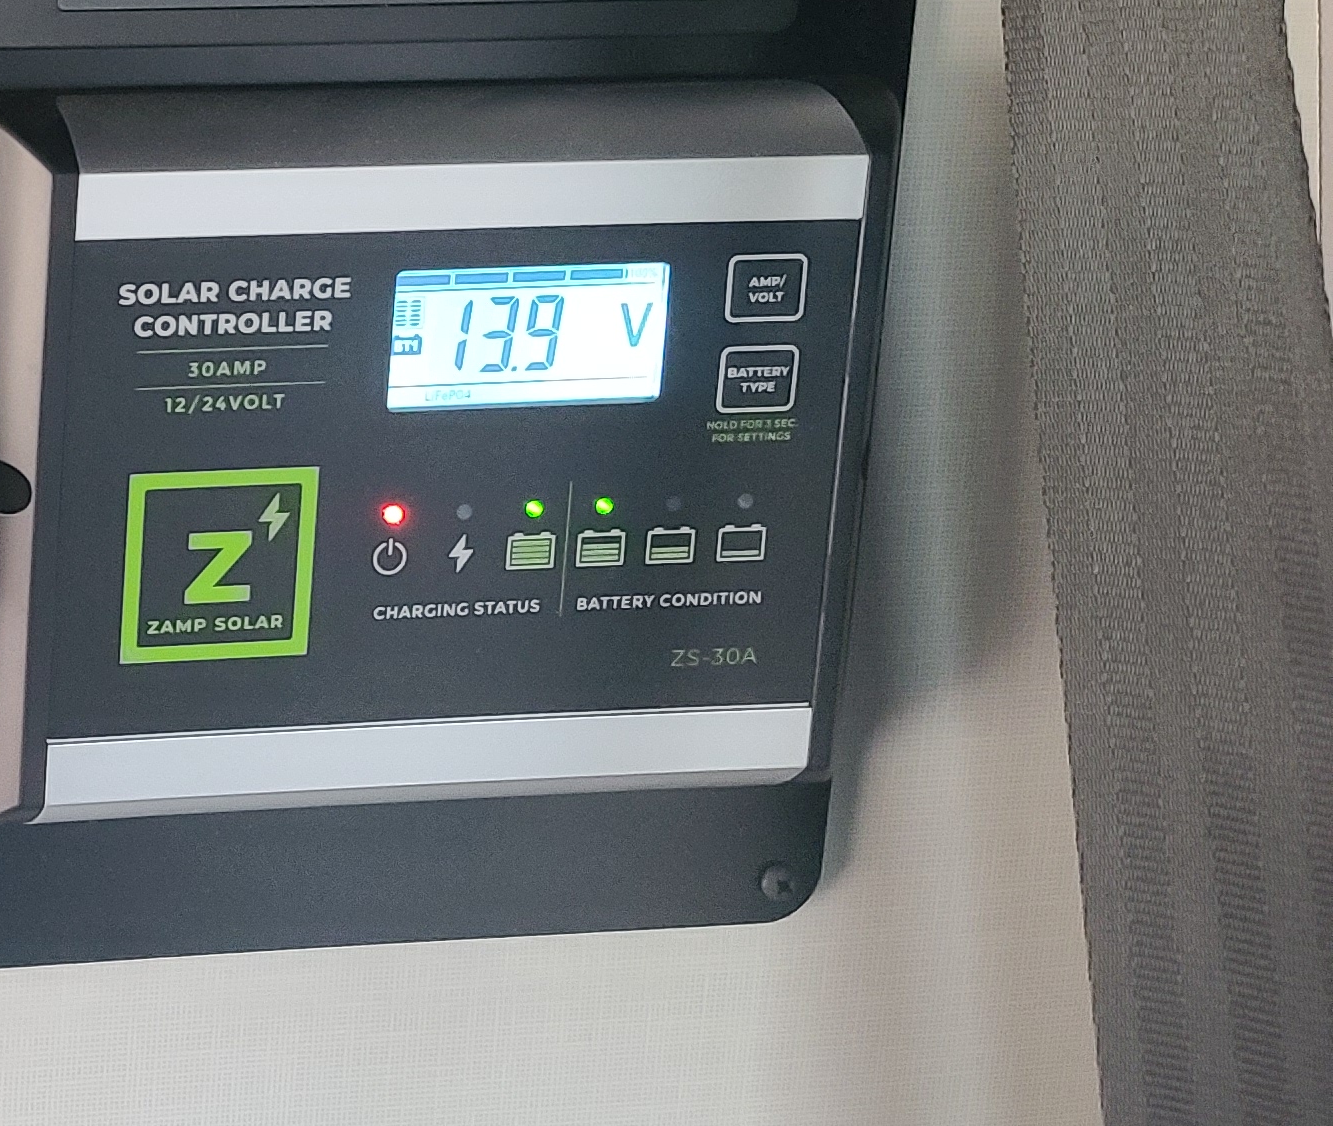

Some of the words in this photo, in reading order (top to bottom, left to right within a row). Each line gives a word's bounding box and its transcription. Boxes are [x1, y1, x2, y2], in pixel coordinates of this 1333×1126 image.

[749, 274, 786, 288] AMP/
[119, 280, 217, 308] SOLAR
[227, 276, 352, 304] CHARGE
[749, 292, 784, 303] VOLT
[134, 310, 333, 339] CONTROLLER
[455, 294, 564, 372] 13.9
[620, 302, 653, 347] V
[188, 360, 267, 379] 30AMP
[727, 366, 789, 378] BATTERY
[740, 382, 775, 393] TYPE
[164, 392, 286, 415] 12/24VOLT
[373, 602, 468, 620] CHARGING
[474, 599, 541, 615] STATUS
[576, 594, 651, 612] BATTERY
[658, 590, 763, 608] CONDITION
[147, 619, 205, 635] ZAMP
[214, 614, 284, 630] SOLAR
[670, 647, 758, 667] ZS-30A
